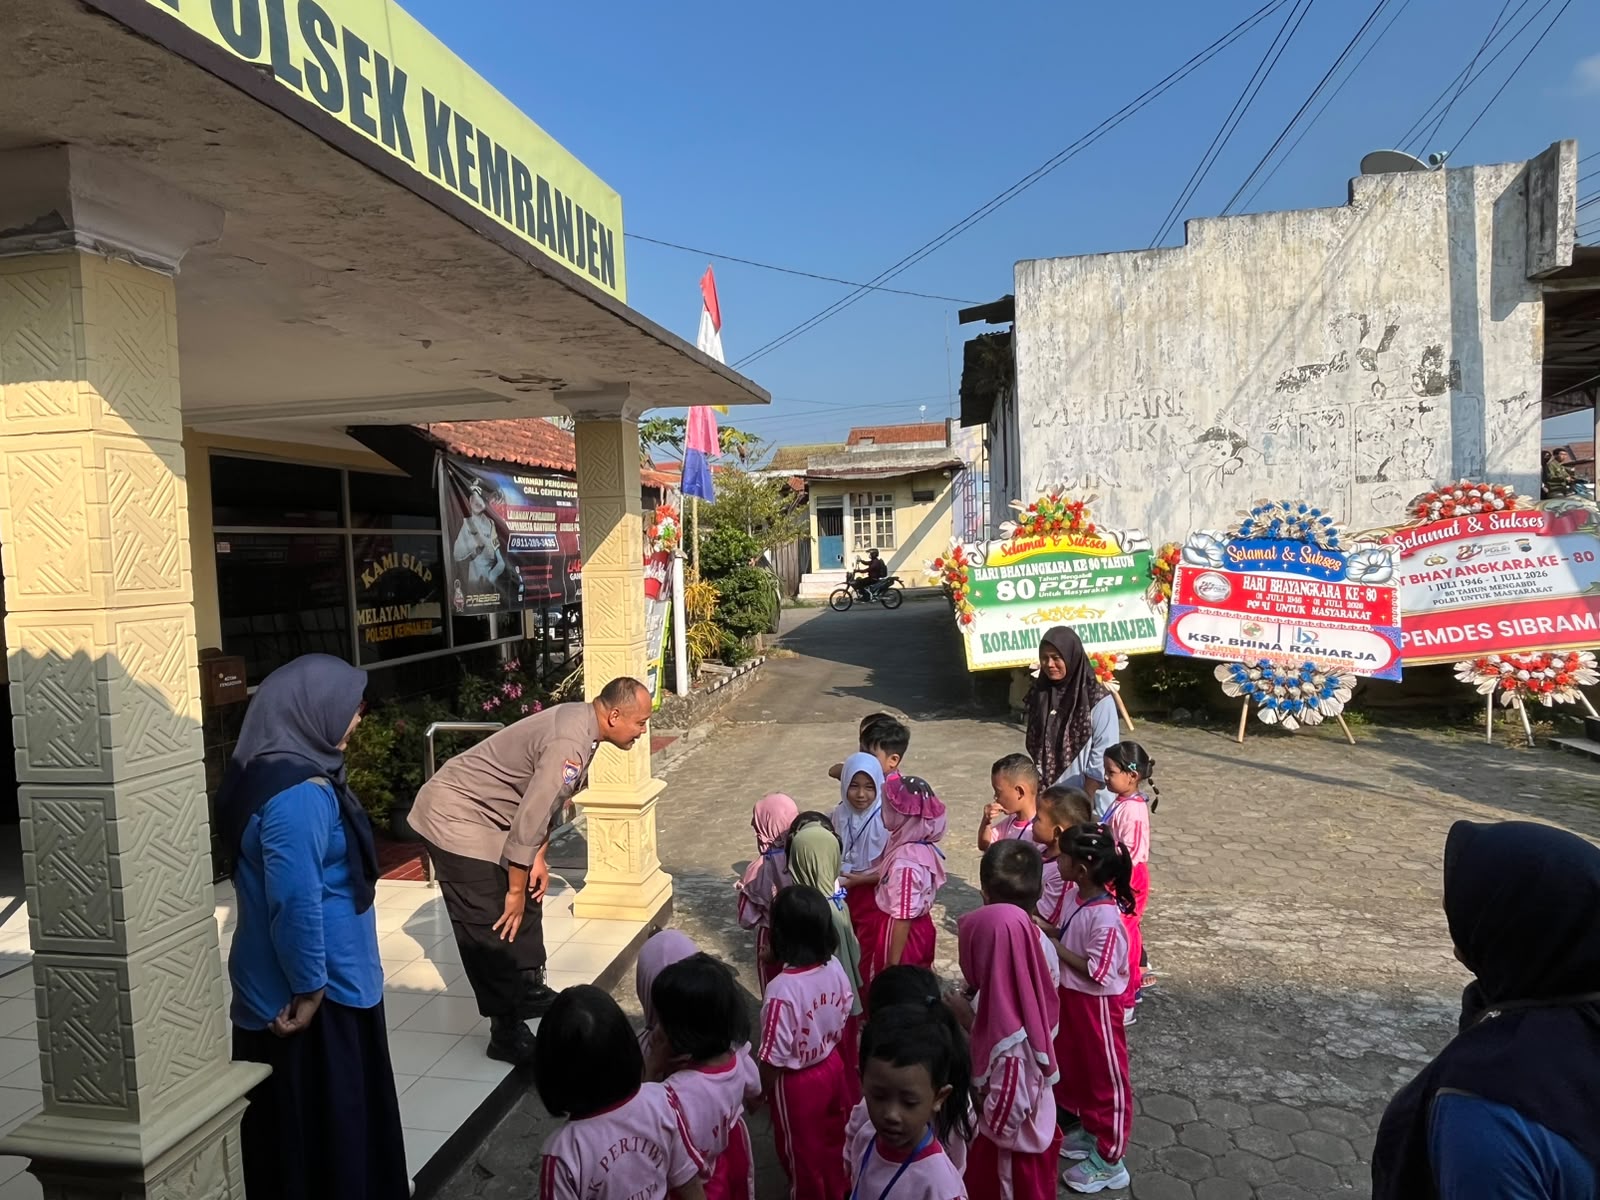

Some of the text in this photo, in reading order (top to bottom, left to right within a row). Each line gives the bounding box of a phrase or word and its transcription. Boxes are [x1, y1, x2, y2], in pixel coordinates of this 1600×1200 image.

[158, 0, 617, 290] OLSEK KEMRANJEN
[1394, 512, 1544, 553] Selamat & Sukses
[1000, 534, 1047, 557] Selamat
[1067, 533, 1107, 550] Sukses
[974, 566, 1000, 581] HARI
[1000, 561, 1072, 579] BHAYANGKARA
[1072, 558, 1088, 572] KE
[1100, 555, 1135, 570] TAHUN
[1226, 545, 1342, 571] Selamat & Sukses
[1409, 557, 1537, 586] BHAYANGKARA
[1537, 554, 1559, 568] KE
[1573, 550, 1595, 564] 80
[361, 552, 433, 589] KAMI SIAP
[1435, 580, 1457, 591] JULI
[1460, 578, 1483, 588] 1946
[1500, 572, 1522, 582] JULI
[1525, 570, 1548, 579] 2026
[996, 578, 1036, 601] 80
[1038, 586, 1109, 598] Untuk Masyarakat
[1039, 575, 1123, 592] POLRI
[1243, 575, 1267, 592] HARI
[1269, 580, 1341, 599] BHAYANGKARA
[1432, 585, 1553, 606] POLRI UNTUK MASYARAKAT
[1457, 586, 1488, 596] TAHUN
[1489, 580, 1537, 592] MENGABDI
[1265, 593, 1284, 603] JULI
[1324, 600, 1343, 609] JULI
[1275, 603, 1306, 615] UNTUK
[1311, 607, 1372, 621] MASYARAKAT
[356, 604, 411, 625] MELAYANI
[1071, 617, 1157, 645] EMRANJEN
[1400, 612, 1600, 648] PEMDES SIBRAM
[1188, 632, 1377, 663] KSP. BHINA RAHARJA
[599, 1136, 665, 1174] PERTIWI
